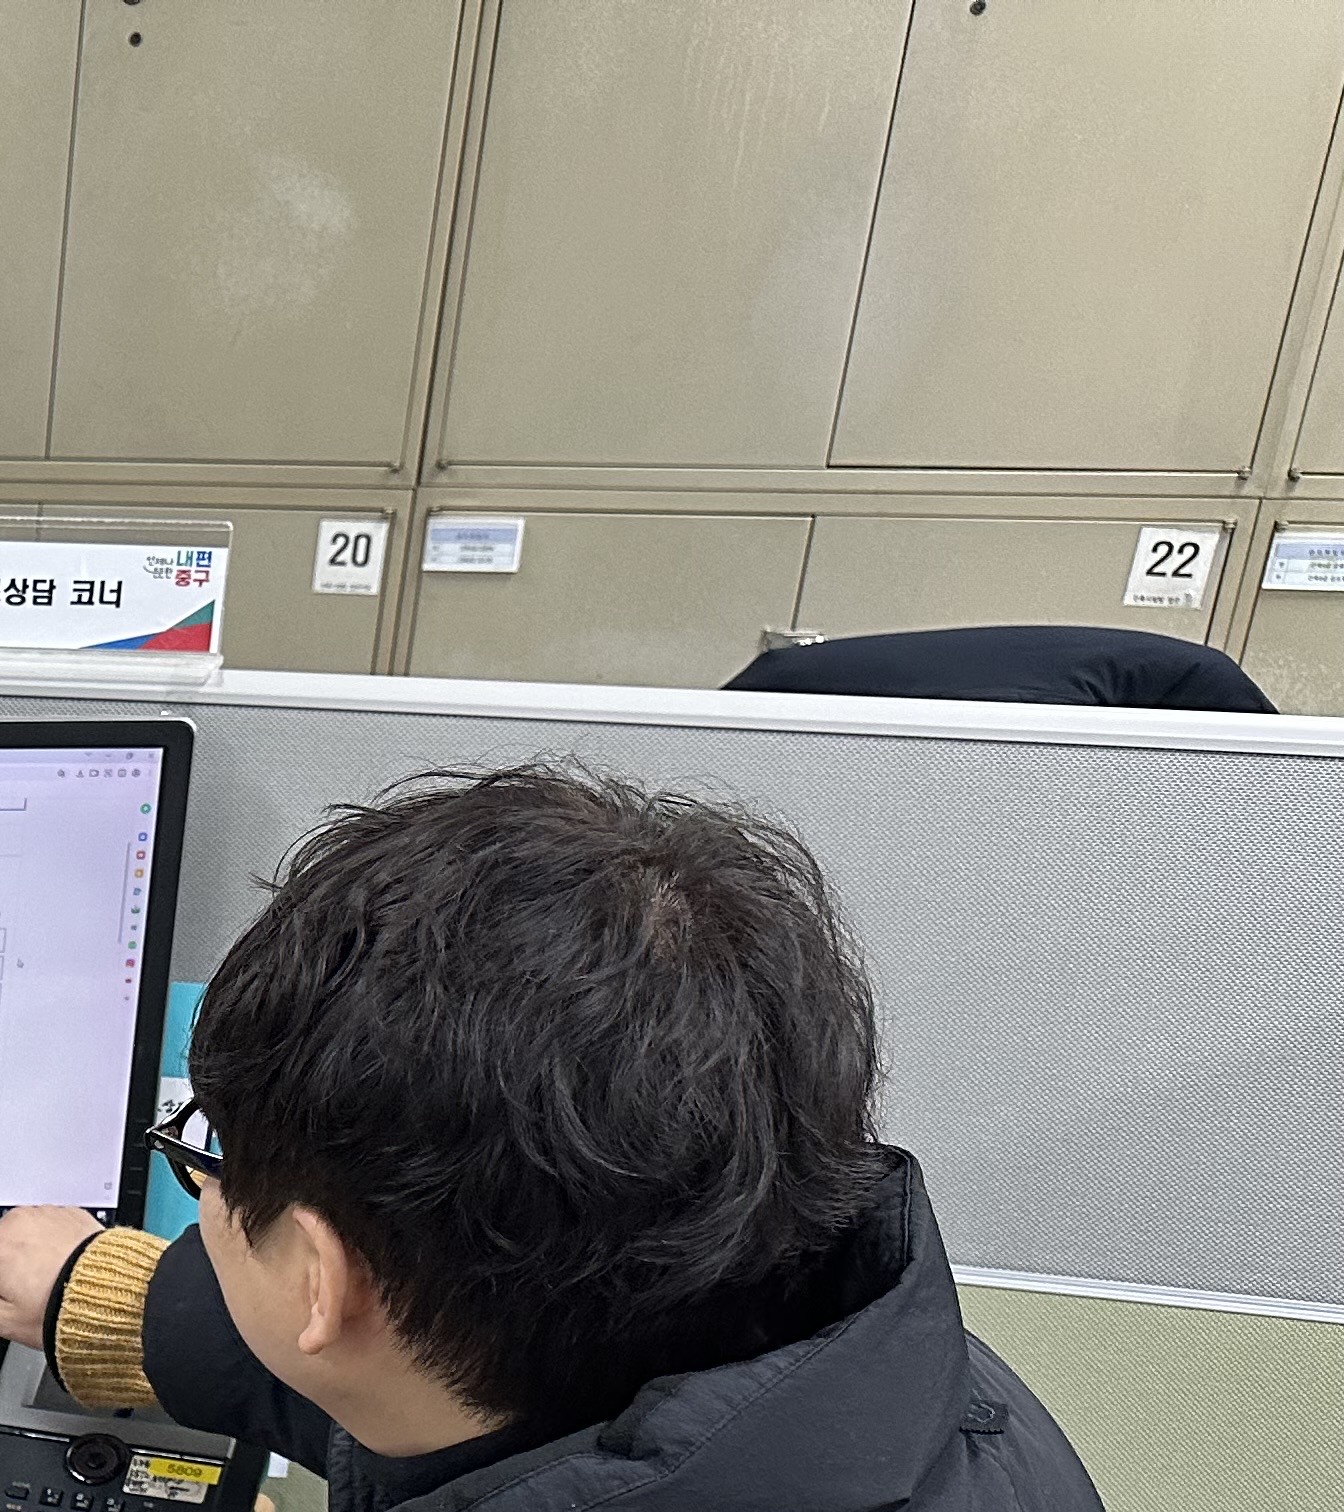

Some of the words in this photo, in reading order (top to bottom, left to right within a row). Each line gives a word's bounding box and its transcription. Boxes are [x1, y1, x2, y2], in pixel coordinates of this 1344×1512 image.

[176, 550, 212, 568] 내편
[329, 532, 371, 567] 20
[1146, 541, 1200, 579] 22
[175, 569, 211, 588] 중구
[70, 579, 124, 609] 코너
